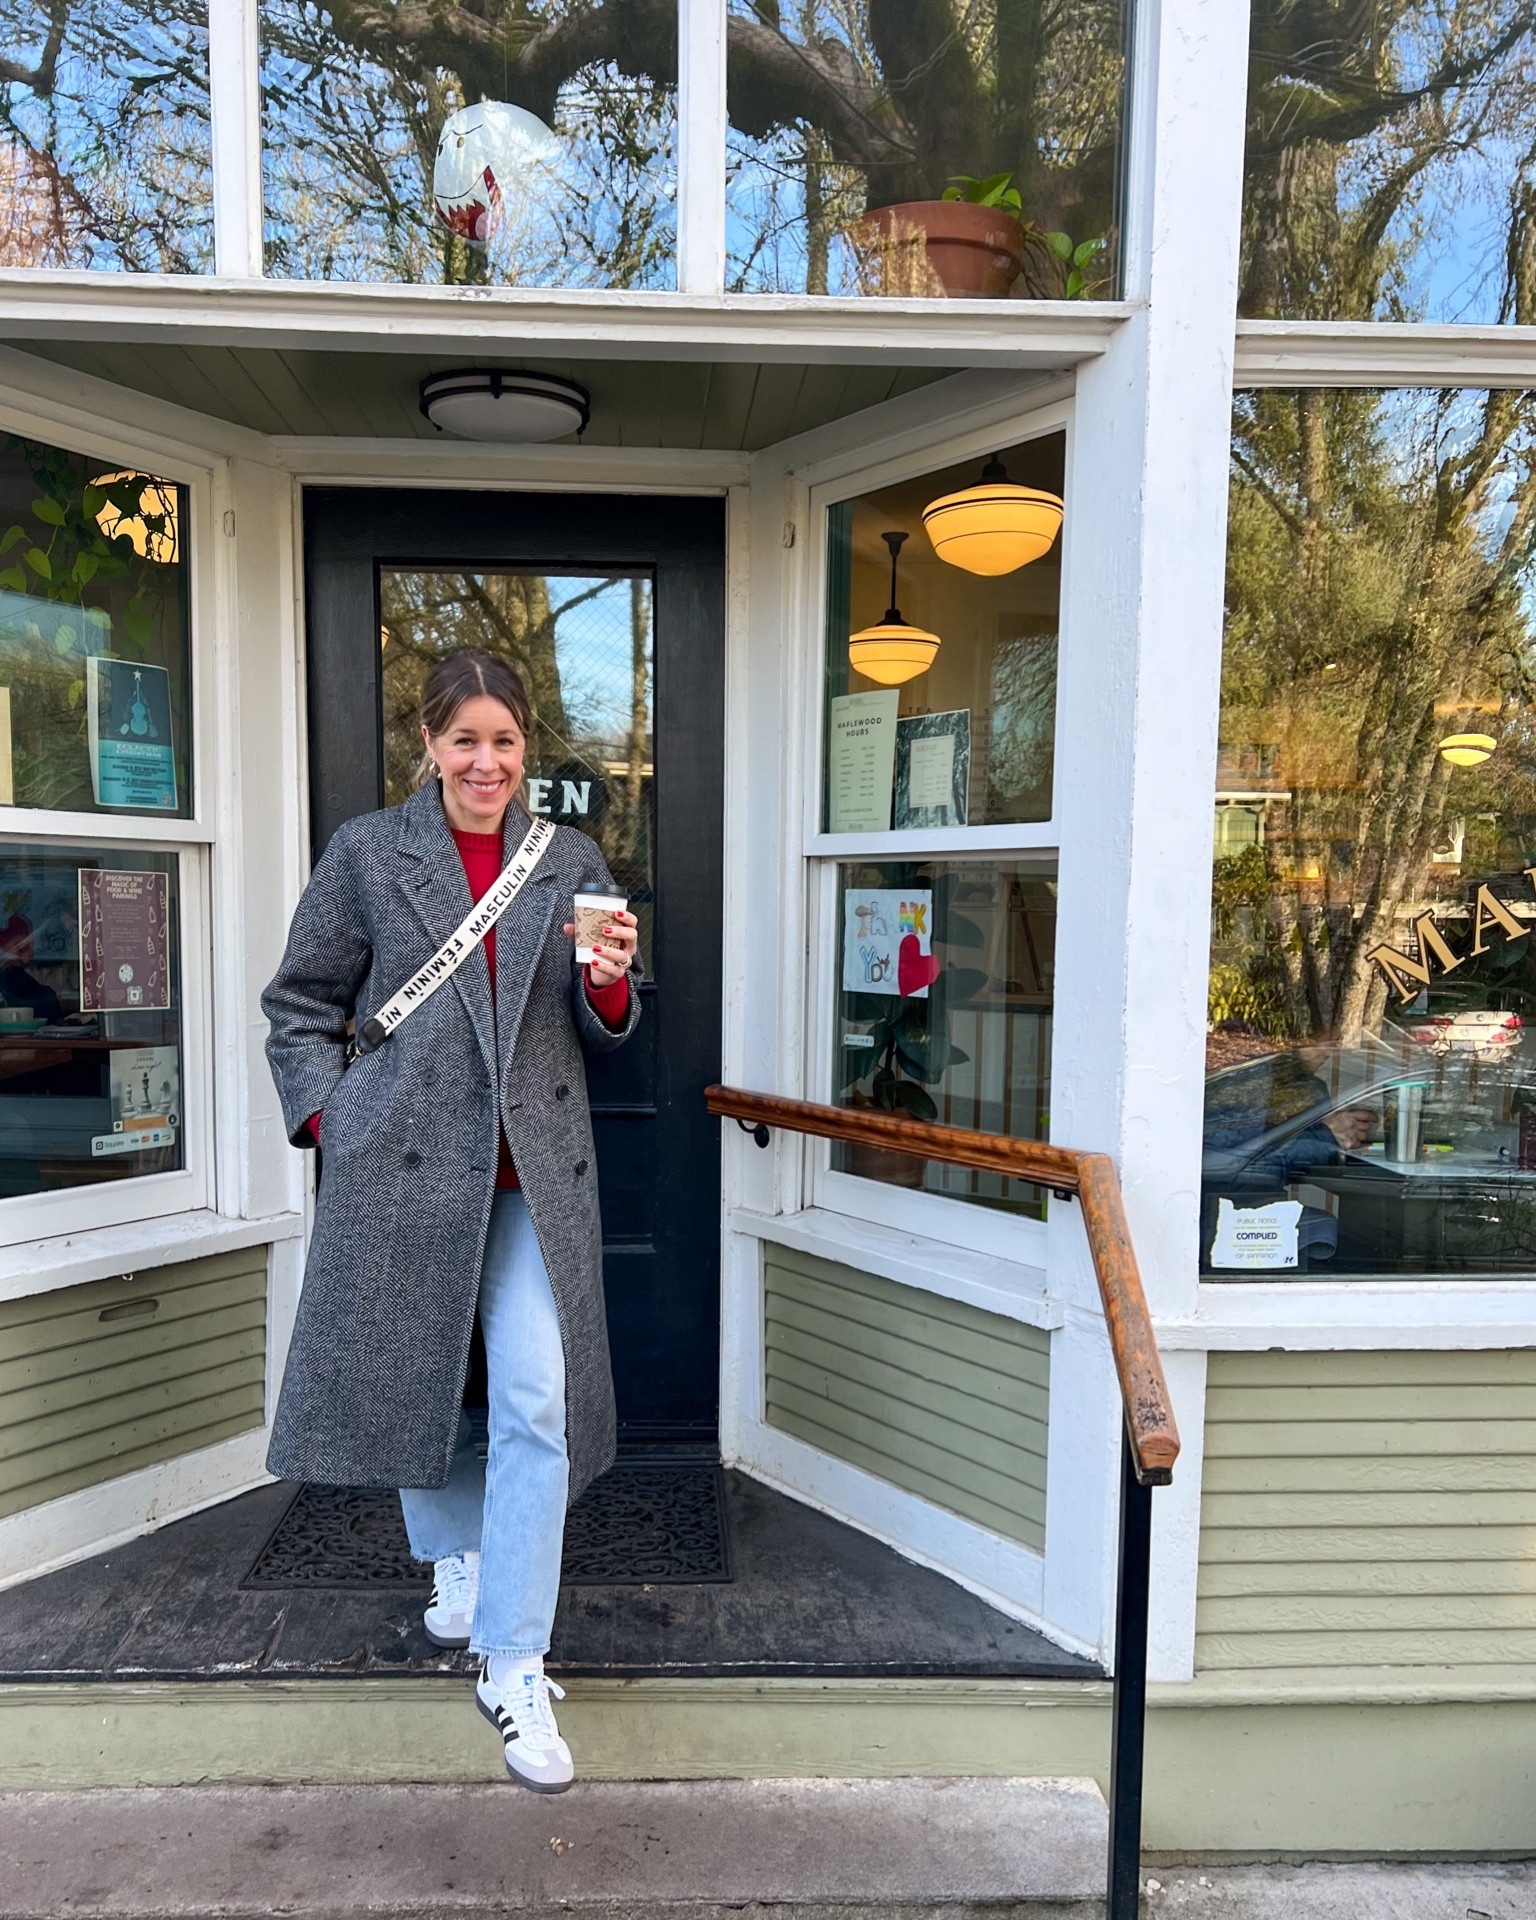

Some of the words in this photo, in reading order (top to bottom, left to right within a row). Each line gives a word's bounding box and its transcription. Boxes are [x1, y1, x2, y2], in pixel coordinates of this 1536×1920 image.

[837, 717, 882, 729] MAPLEWOOD
[846, 728, 869, 737] HOURS
[527, 778, 592, 814] EN
[1363, 868, 1536, 1006] MA
[1236, 1232, 1278, 1240] COMPLIED
